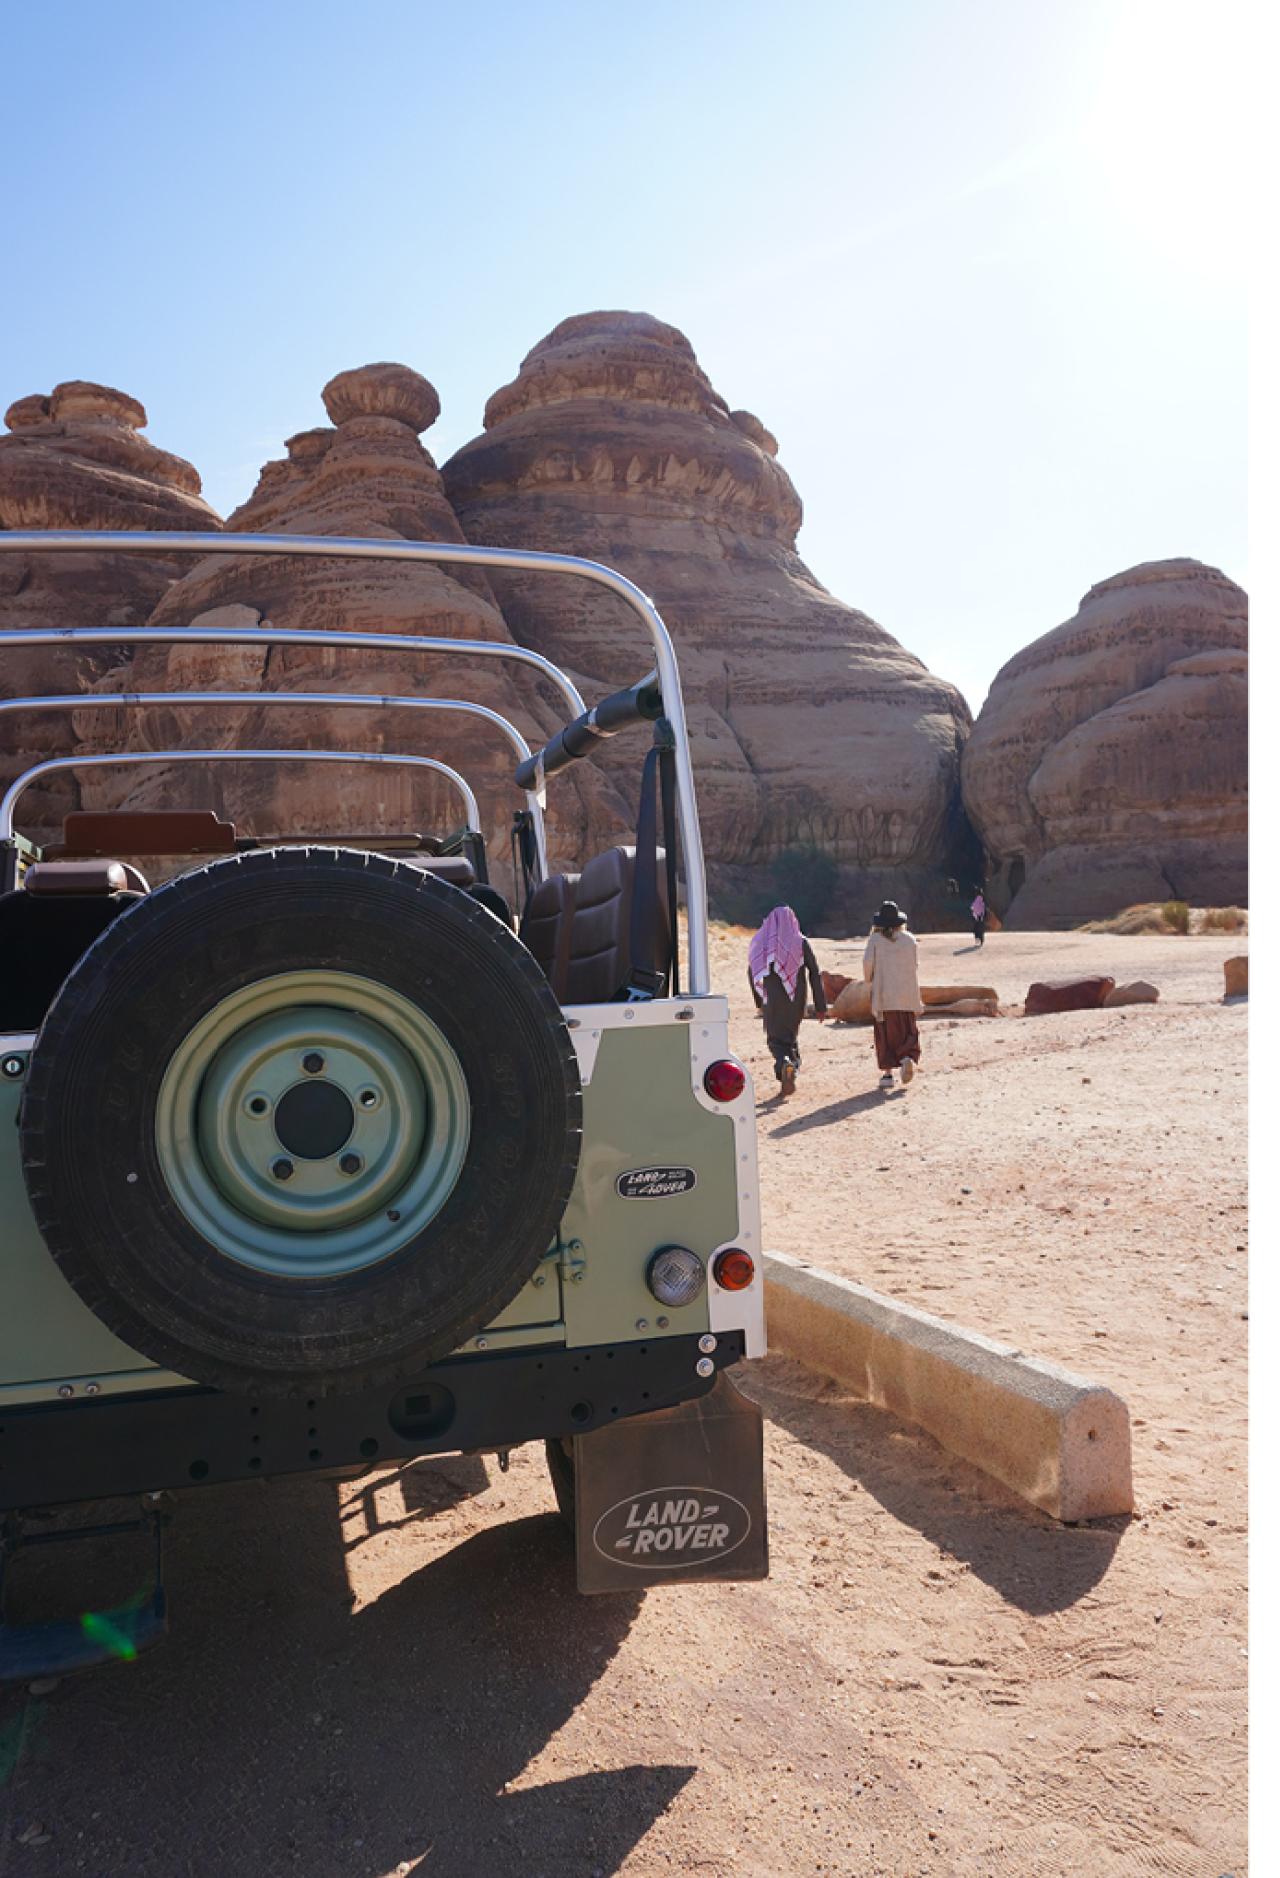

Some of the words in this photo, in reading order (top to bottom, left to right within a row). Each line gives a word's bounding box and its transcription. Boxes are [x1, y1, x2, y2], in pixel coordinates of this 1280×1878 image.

[628, 1171, 659, 1184] LAND
[648, 1180, 686, 1195] ROVER
[626, 1498, 700, 1529] LAND
[632, 1523, 730, 1555] ROVER
